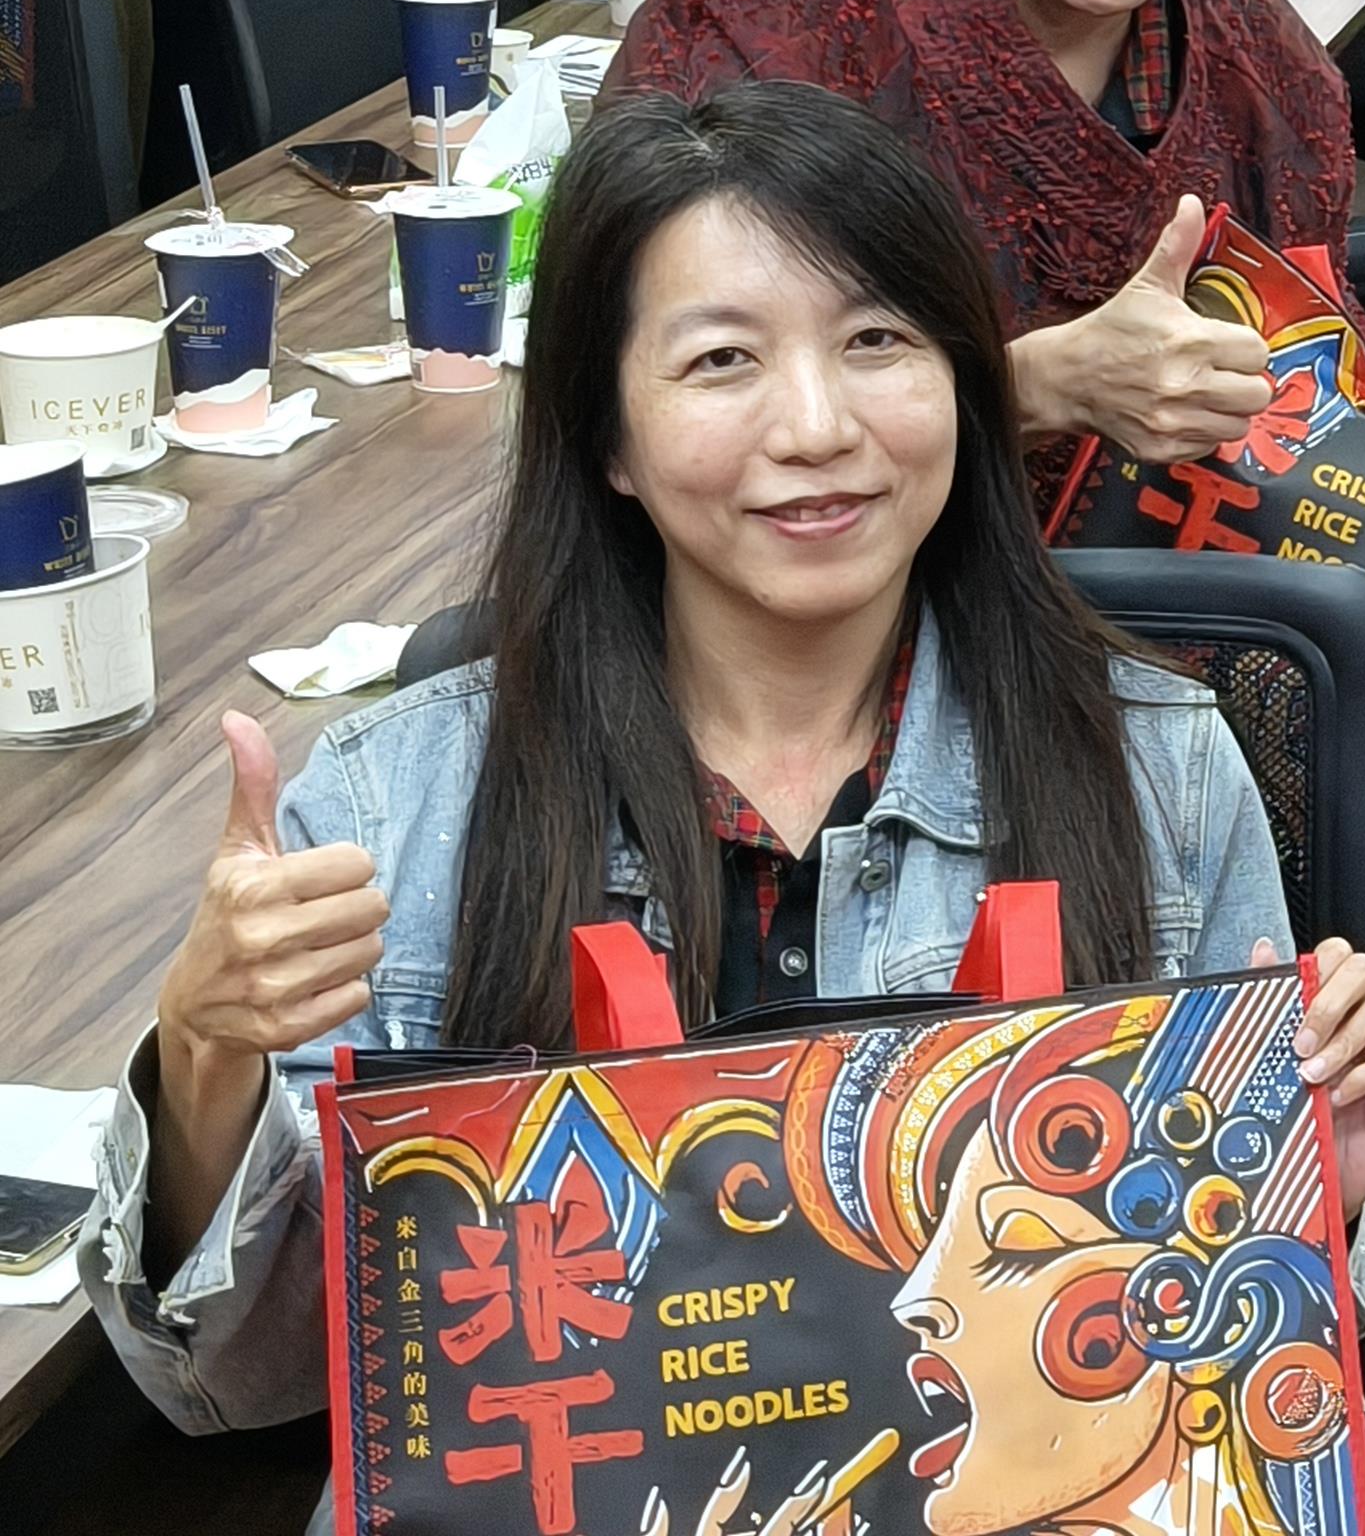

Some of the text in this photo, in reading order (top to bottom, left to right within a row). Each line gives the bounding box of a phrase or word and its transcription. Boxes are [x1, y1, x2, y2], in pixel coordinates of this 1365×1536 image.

[31, 389, 146, 420] ICEVER
[1293, 497, 1363, 545] RICE
[658, 1278, 795, 1326] CRISPY
[661, 1340, 749, 1382] RICE
[665, 1380, 849, 1438] NOODLES
